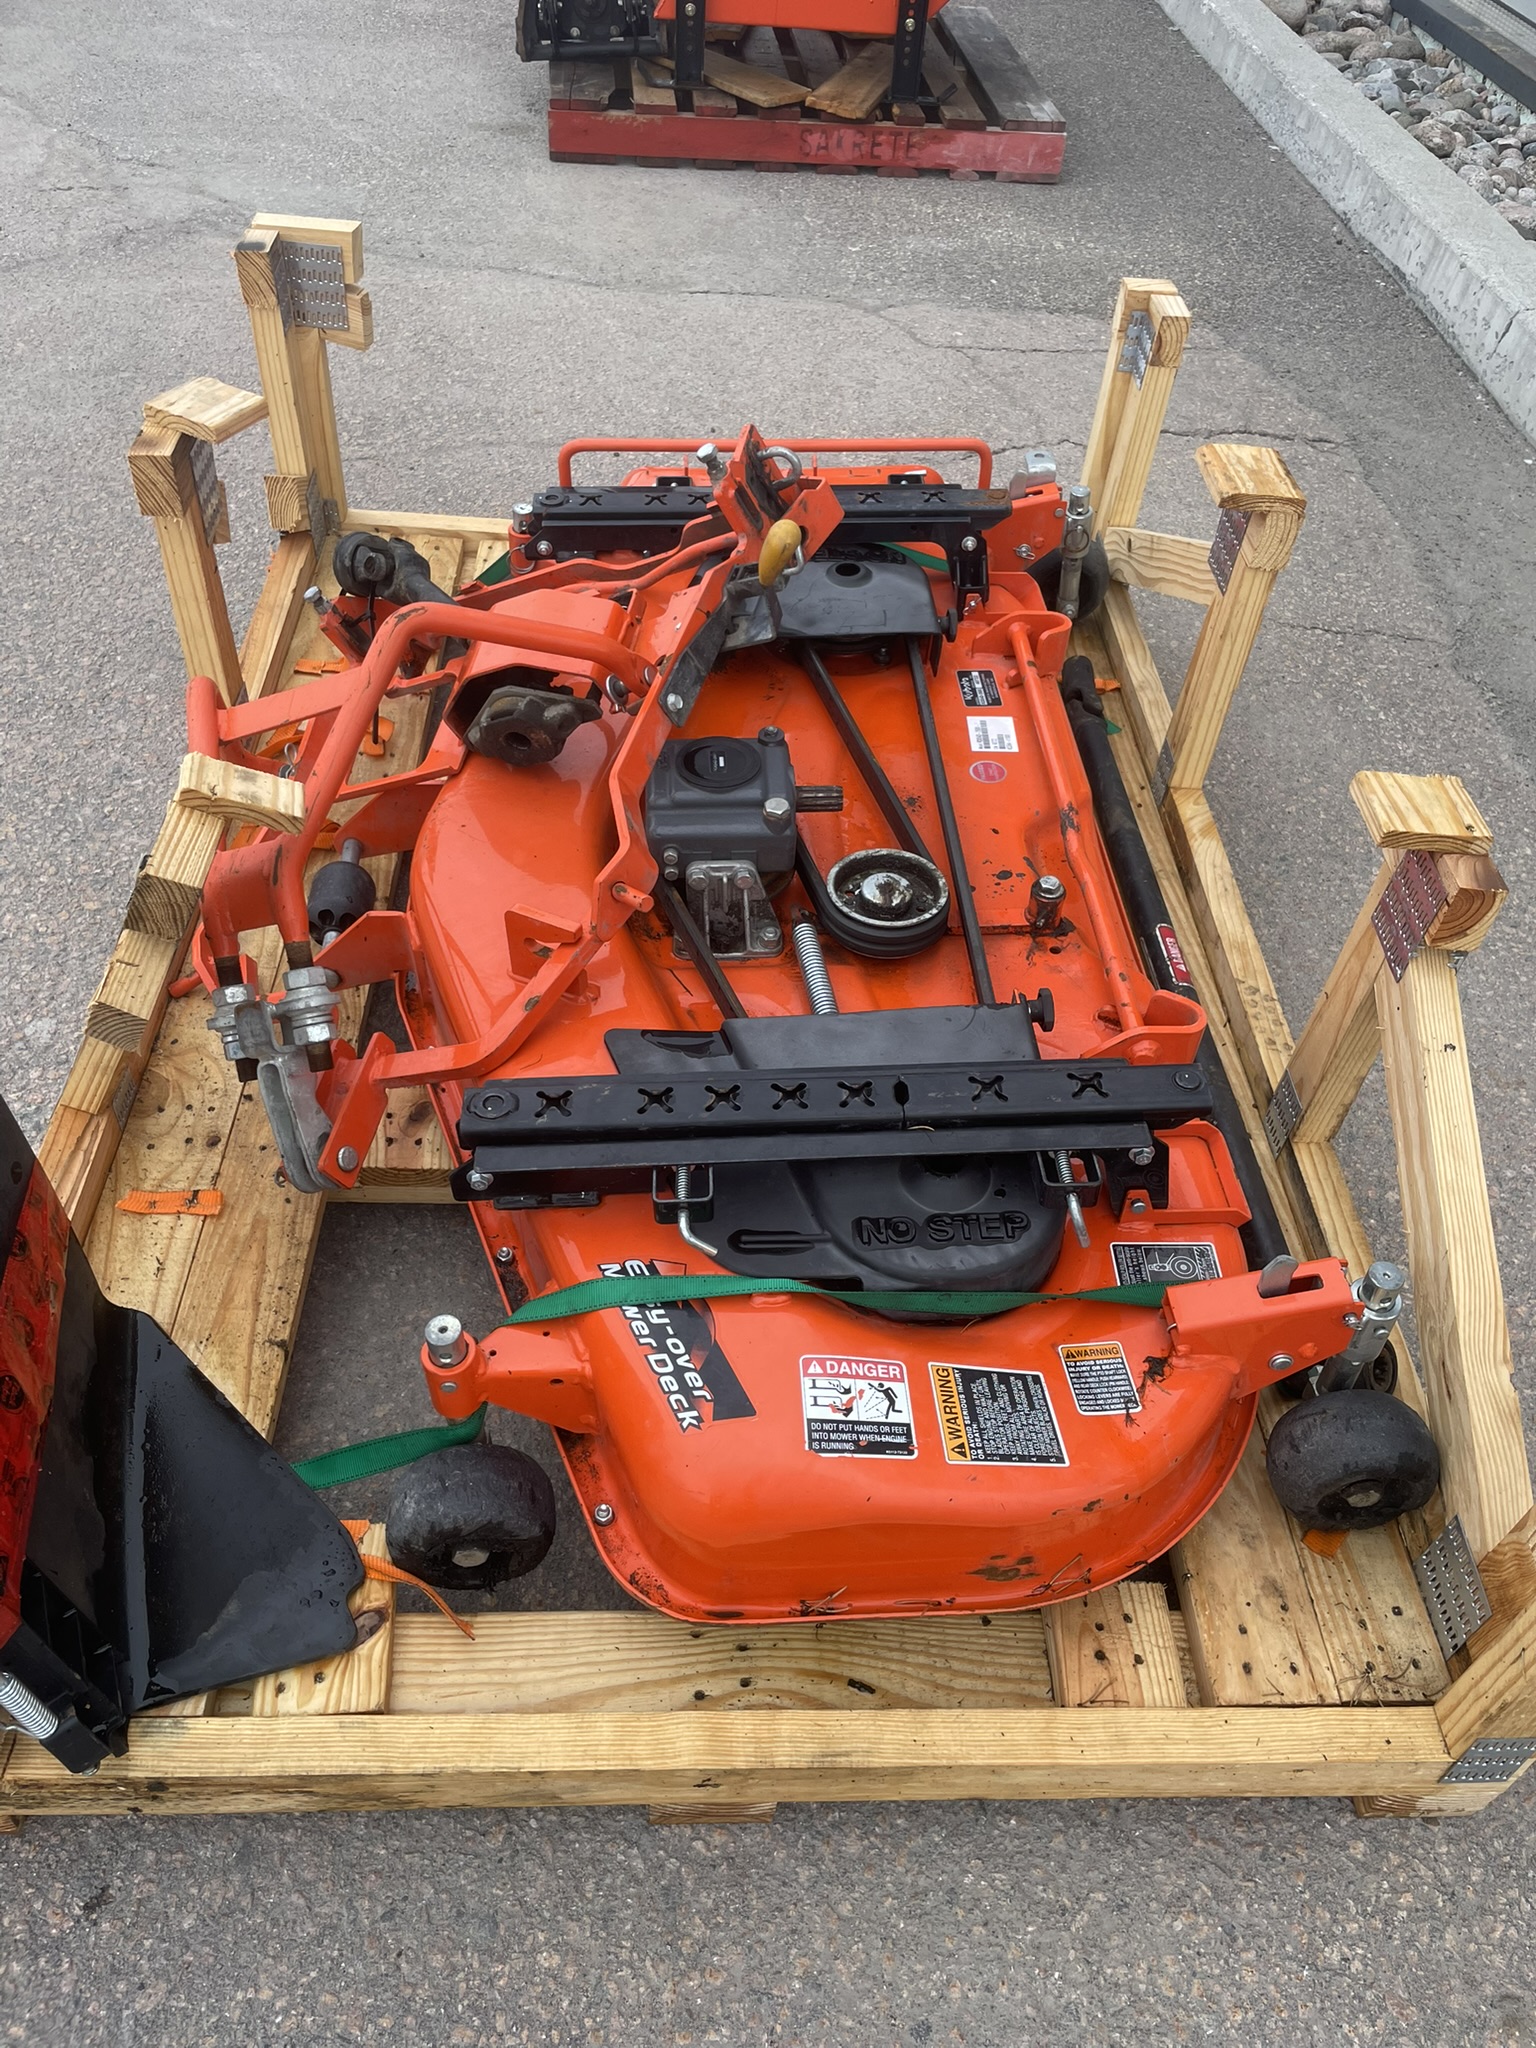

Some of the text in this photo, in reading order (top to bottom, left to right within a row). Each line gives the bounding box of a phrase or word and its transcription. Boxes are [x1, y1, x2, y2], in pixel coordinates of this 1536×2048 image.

[860, 1211, 1031, 1246] NO STEP
[1074, 1347, 1119, 1358] WARNING
[826, 1360, 901, 1378] DANGER
[647, 1354, 699, 1429] Deck
[936, 1367, 966, 1441] WARNING
[953, 1369, 978, 1459] TO AVOID SERIOUS INJURY
[812, 1432, 907, 1443] INTO MOWER WHEN ENGINE
[823, 1423, 837, 1431] NOT
[854, 1425, 878, 1433] HANDS
[892, 1426, 907, 1434] FEET
[977, 1450, 985, 1459] OR
